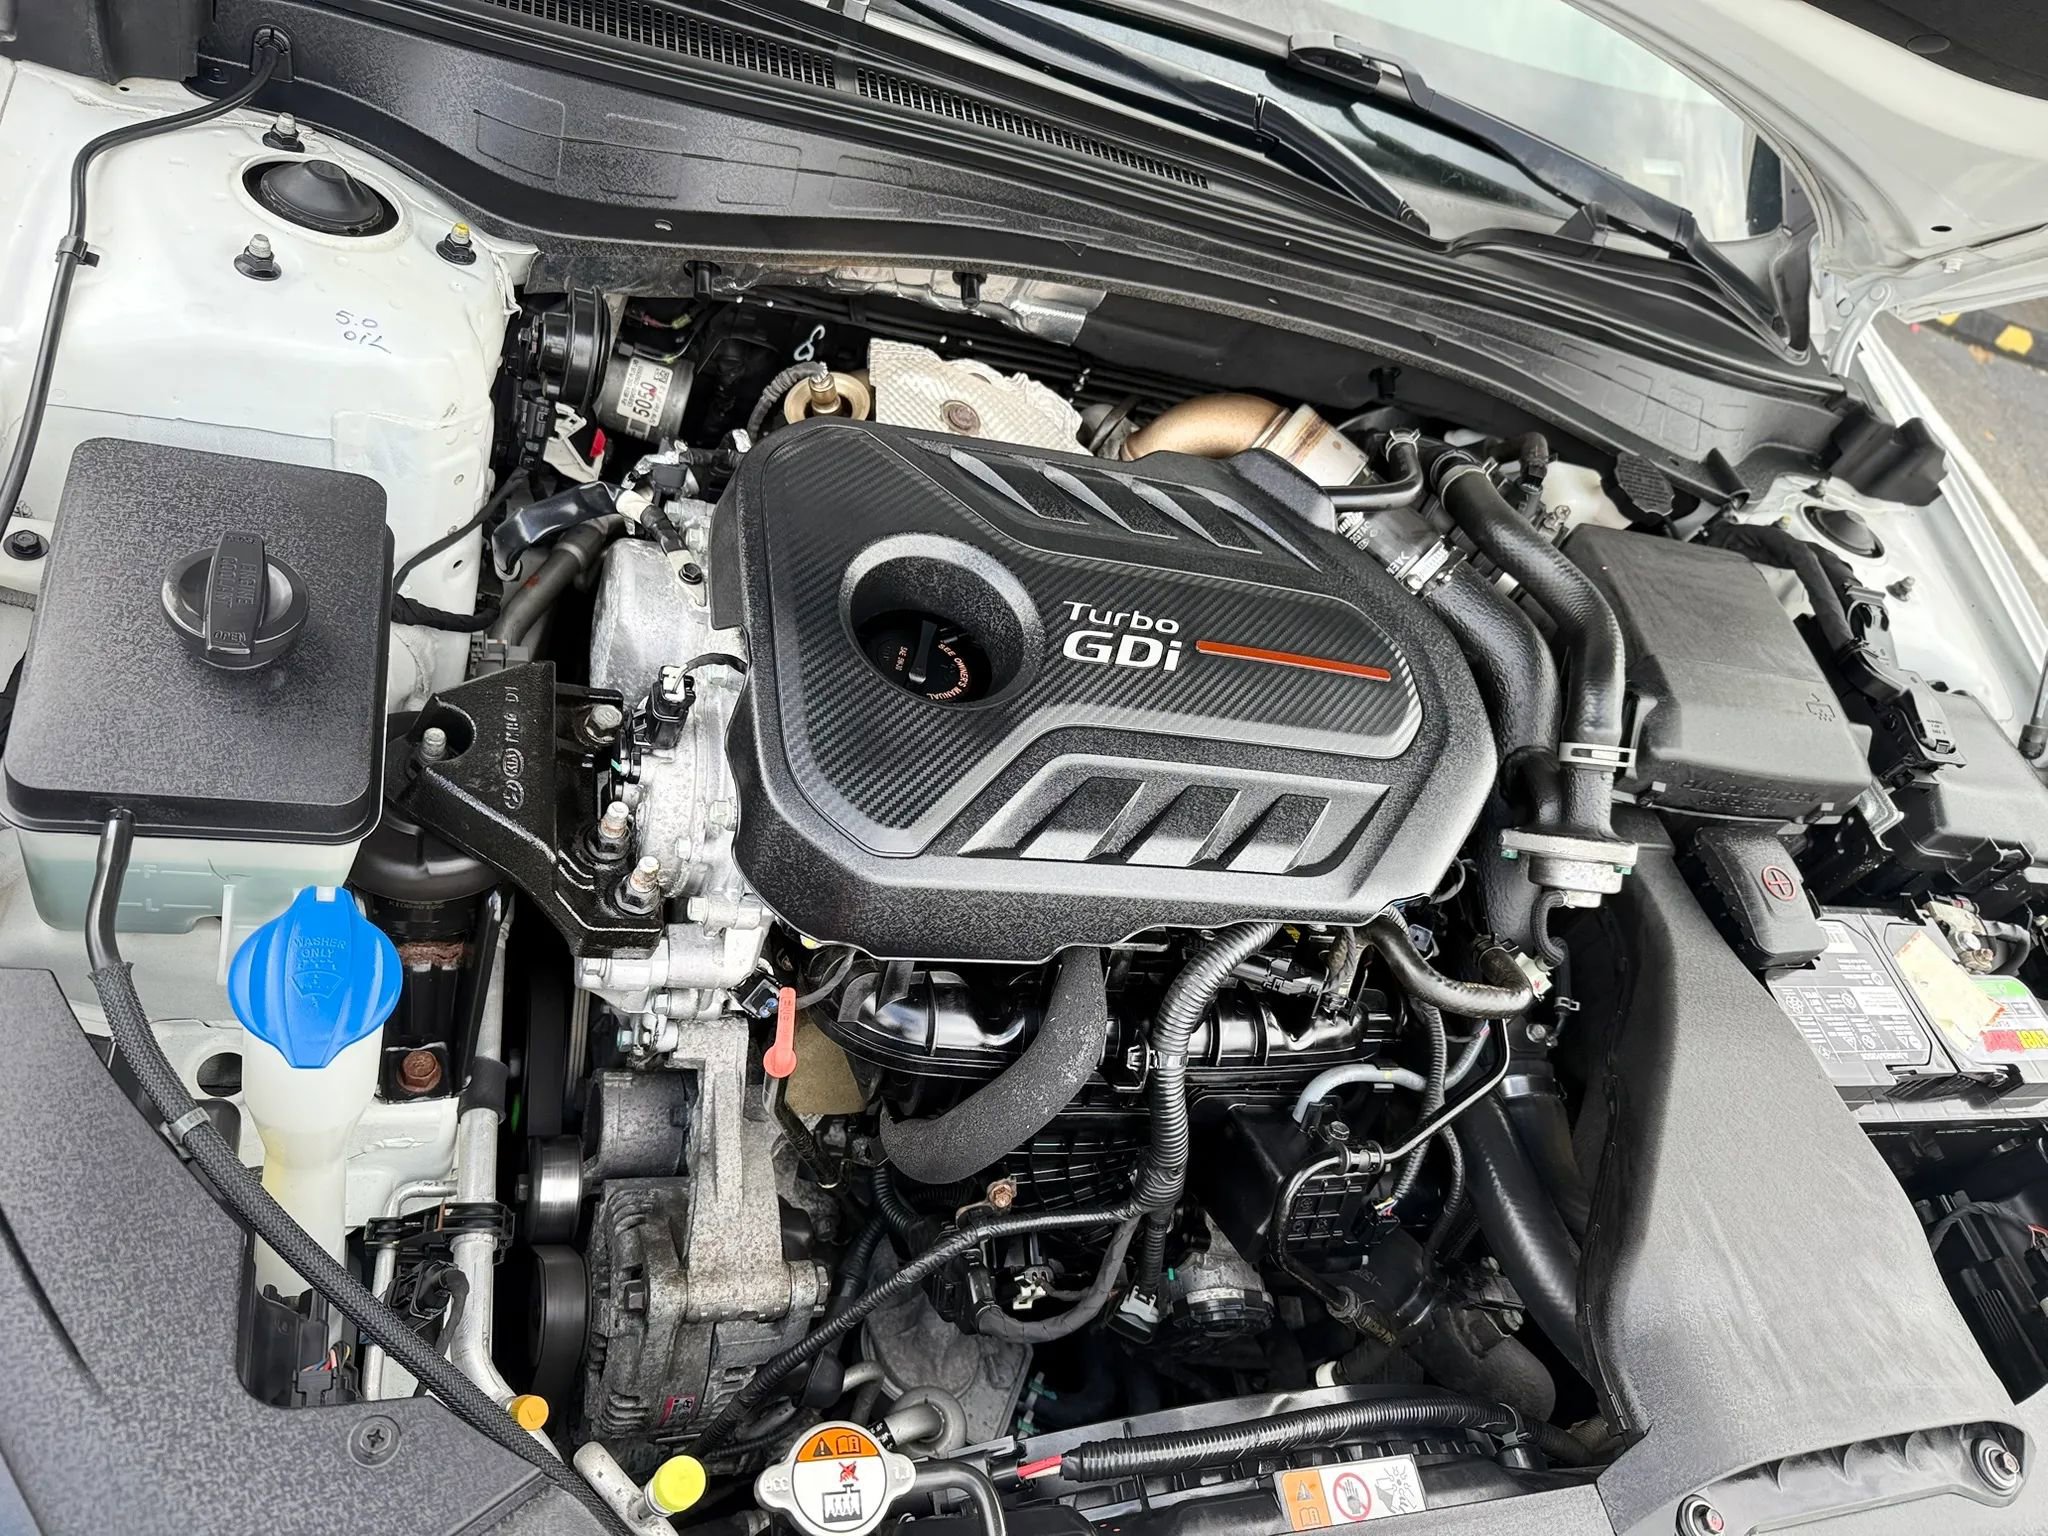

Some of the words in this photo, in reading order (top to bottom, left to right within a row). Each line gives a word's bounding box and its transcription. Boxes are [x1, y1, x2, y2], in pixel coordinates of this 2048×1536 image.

[633, 381, 657, 418] 5050
[1063, 600, 1180, 634] Turbo
[213, 630, 247, 642] OPEN
[938, 643, 957, 657] SEE
[1062, 629, 1182, 672] GDi
[926, 686, 962, 700] MANUAL
[292, 936, 346, 949] WASHER
[302, 947, 334, 959] ONLY
